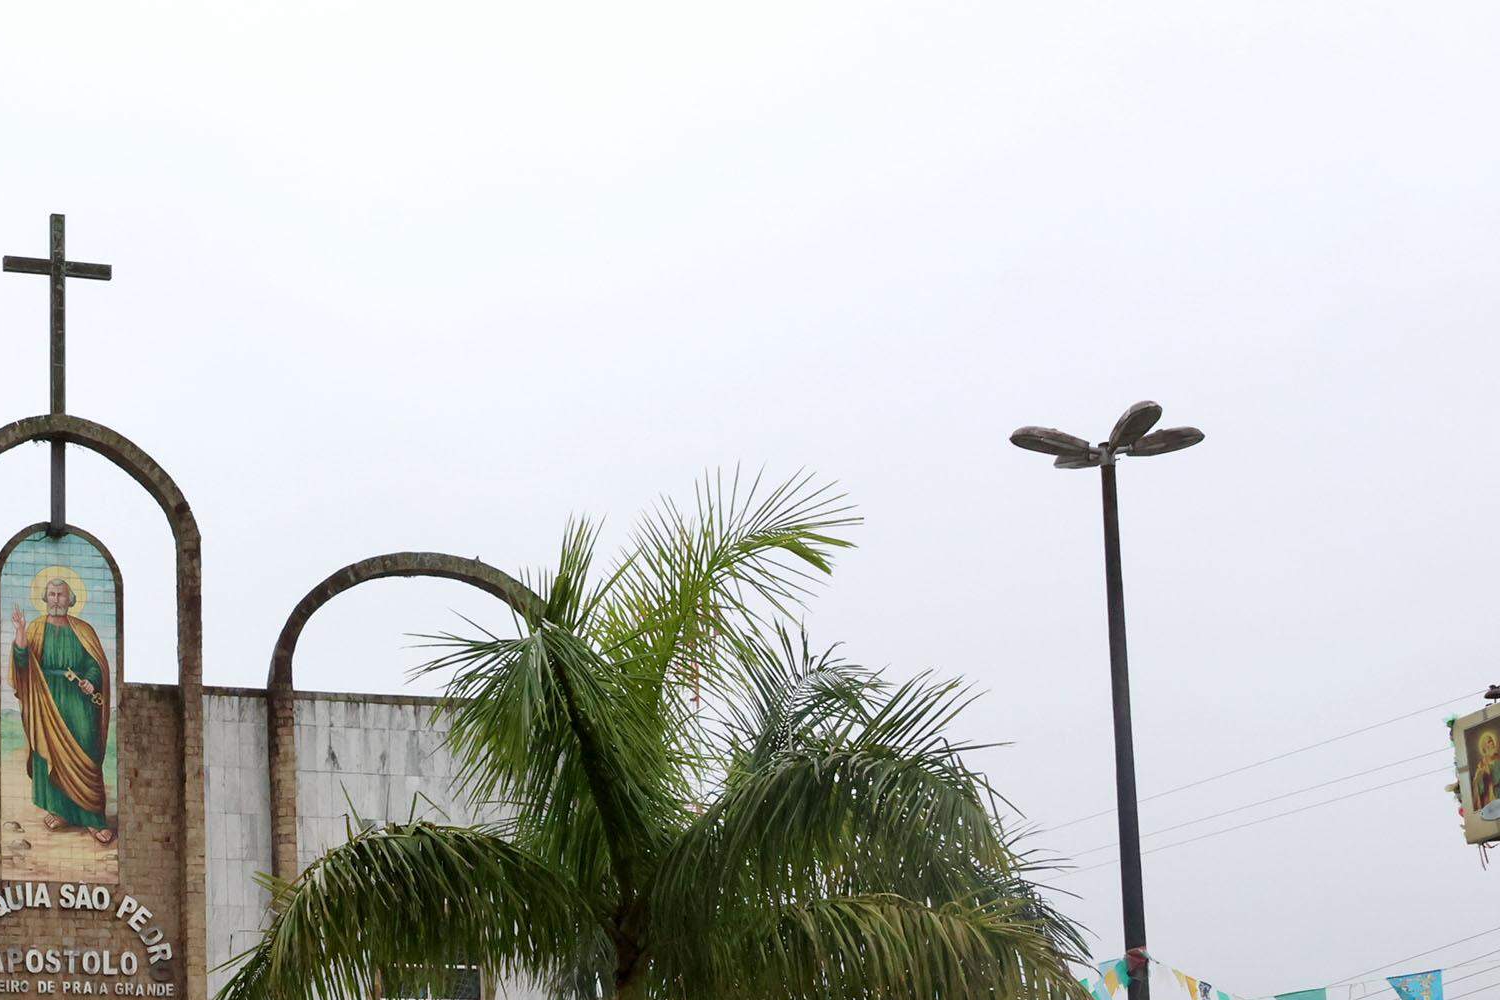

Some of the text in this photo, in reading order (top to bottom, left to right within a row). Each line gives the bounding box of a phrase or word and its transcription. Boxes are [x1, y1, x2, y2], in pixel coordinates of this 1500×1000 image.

[59, 880, 110, 911] SÃO
[116, 895, 174, 981] PEDRO
[37, 981, 56, 994] DE
[62, 981, 109, 995] PRAIA
[115, 982, 175, 997] GRANDE
